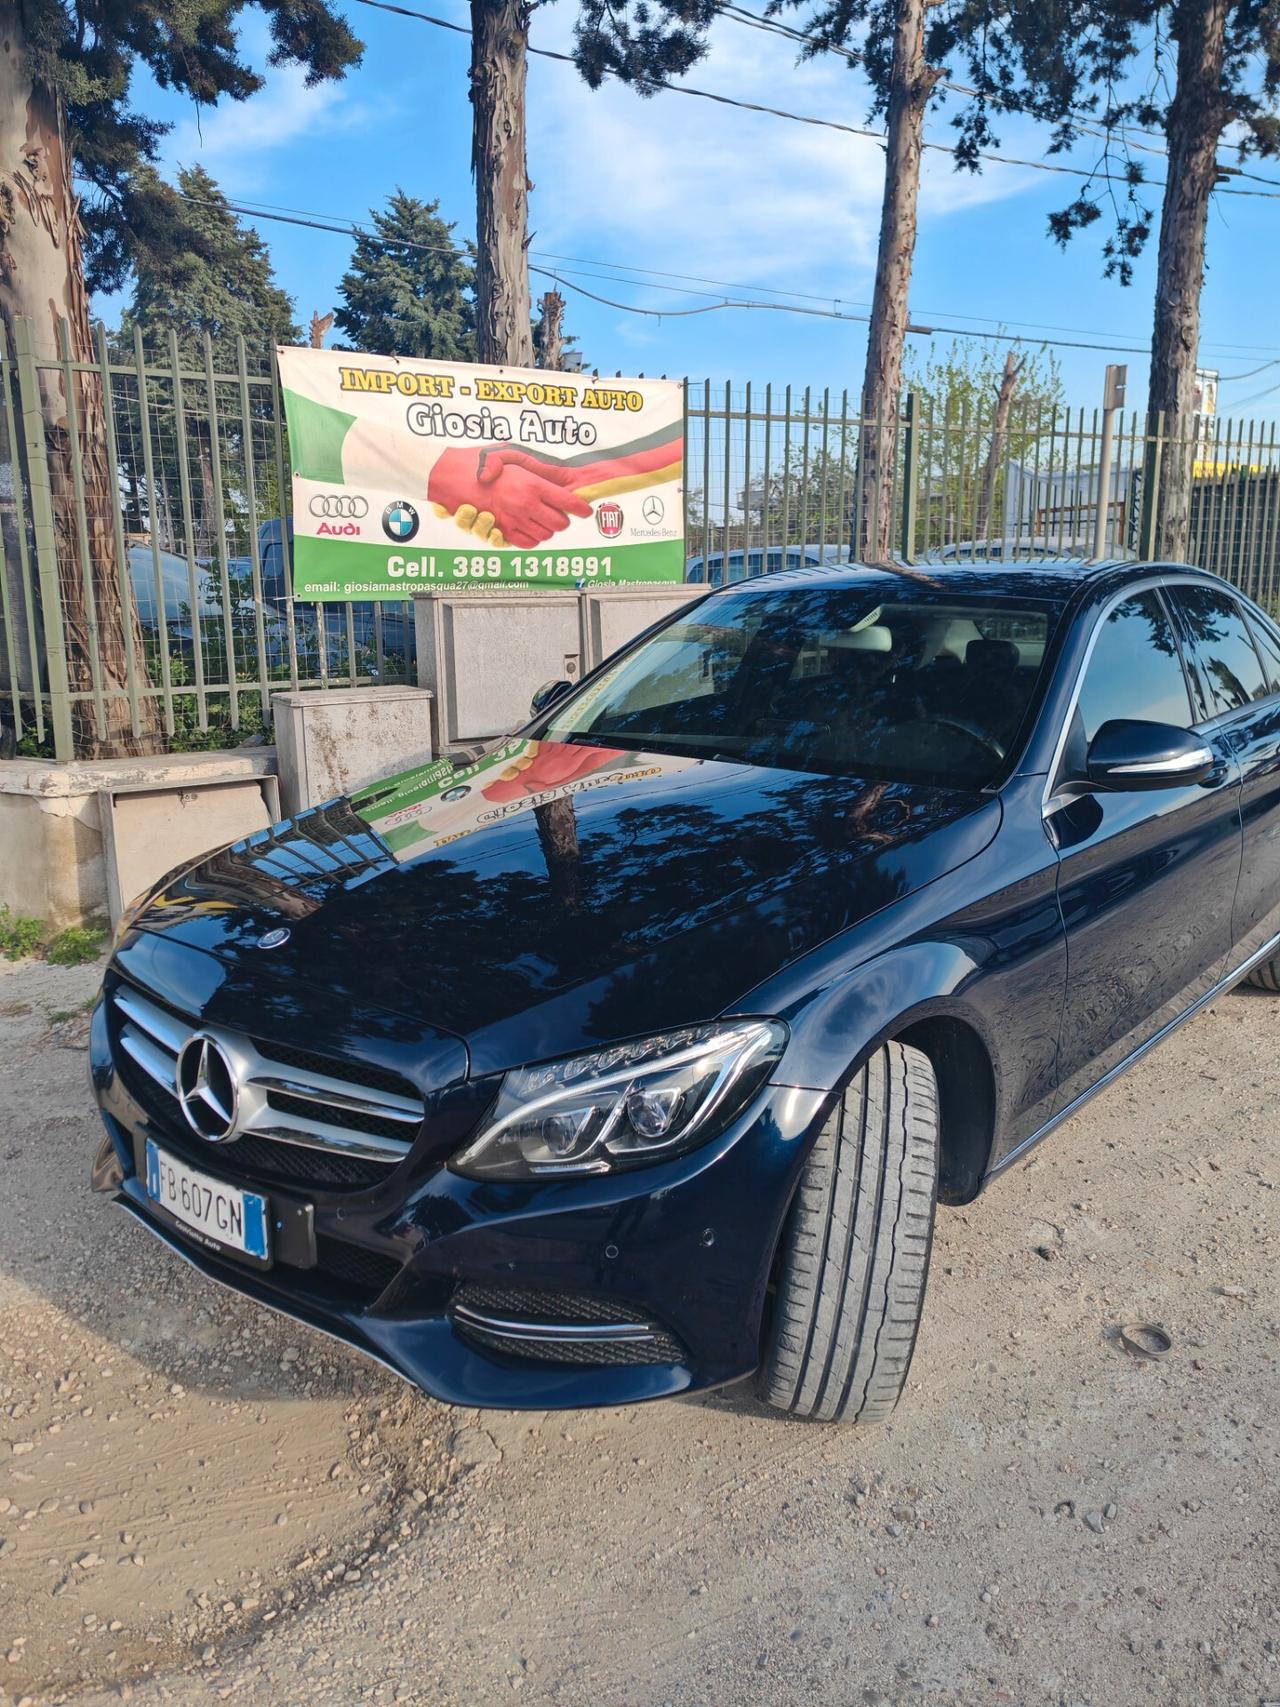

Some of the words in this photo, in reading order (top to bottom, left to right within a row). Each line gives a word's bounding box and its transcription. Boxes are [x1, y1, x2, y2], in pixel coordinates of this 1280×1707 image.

[340, 367, 454, 397] IMPORT
[460, 387, 470, 396] -
[475, 378, 577, 407] EXPORT
[582, 388, 643, 412] AUTO
[406, 402, 512, 440] Giosia
[519, 410, 597, 446] Auto
[316, 522, 360, 536] Audi
[602, 511, 619, 529] FIAT
[387, 555, 443, 578] Cell.
[453, 555, 501, 577] 389
[510, 555, 612, 577] 1318991
[304, 581, 341, 593] email:
[587, 579, 616, 589] Giosia
